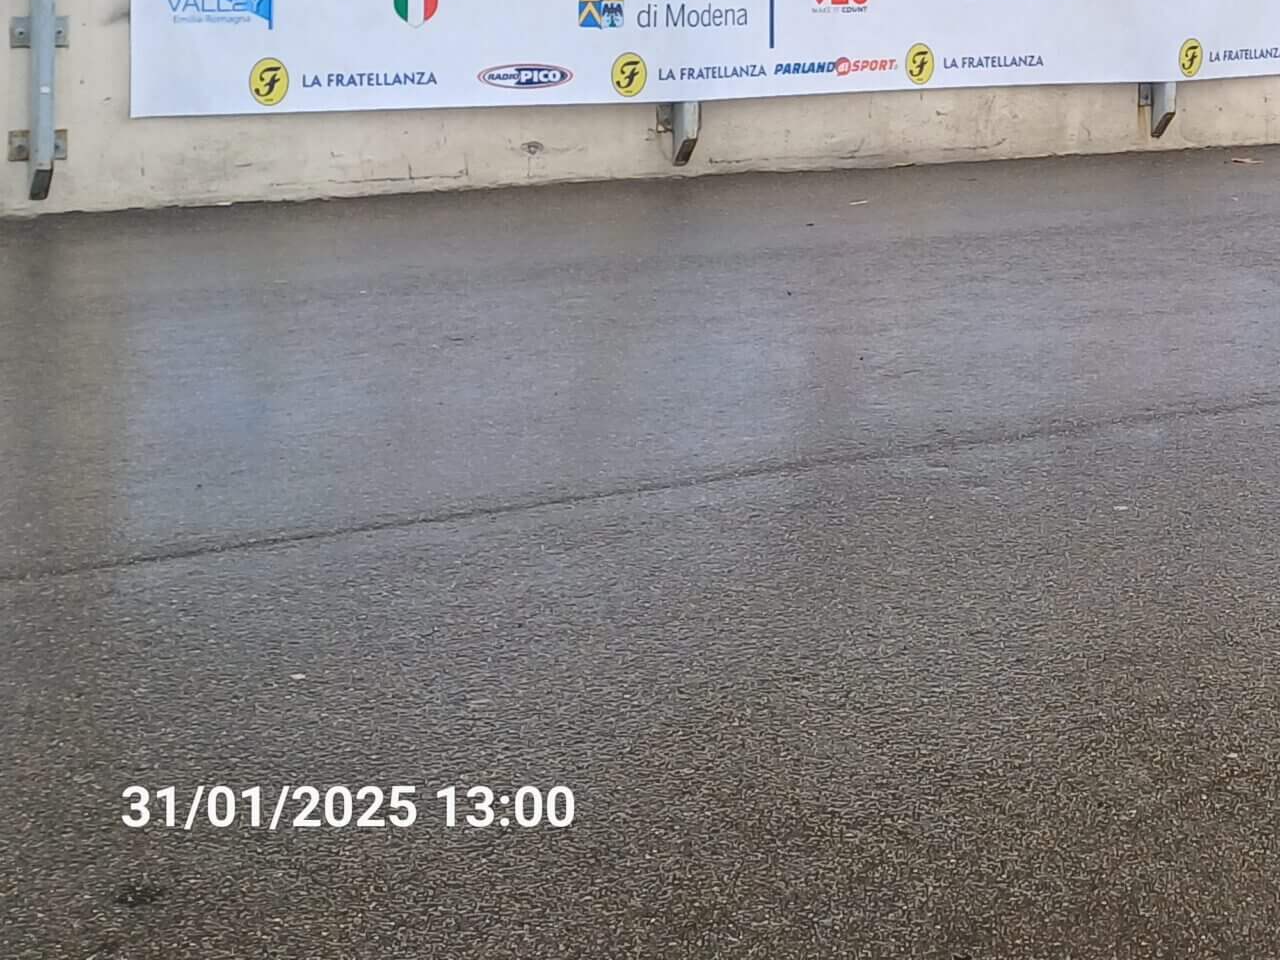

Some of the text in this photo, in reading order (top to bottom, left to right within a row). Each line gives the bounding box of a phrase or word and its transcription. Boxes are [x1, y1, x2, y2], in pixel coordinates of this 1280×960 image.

[636, 3, 749, 28] di Modena
[943, 56, 958, 70] LA
[961, 55, 1044, 70] FRATELLANZA
[1209, 51, 1221, 63] LA
[302, 72, 323, 88] LA
[327, 71, 438, 88] FRATELLANZA
[519, 70, 562, 83] PICO
[658, 66, 676, 81] LA
[680, 64, 767, 80] FRATELLANZA
